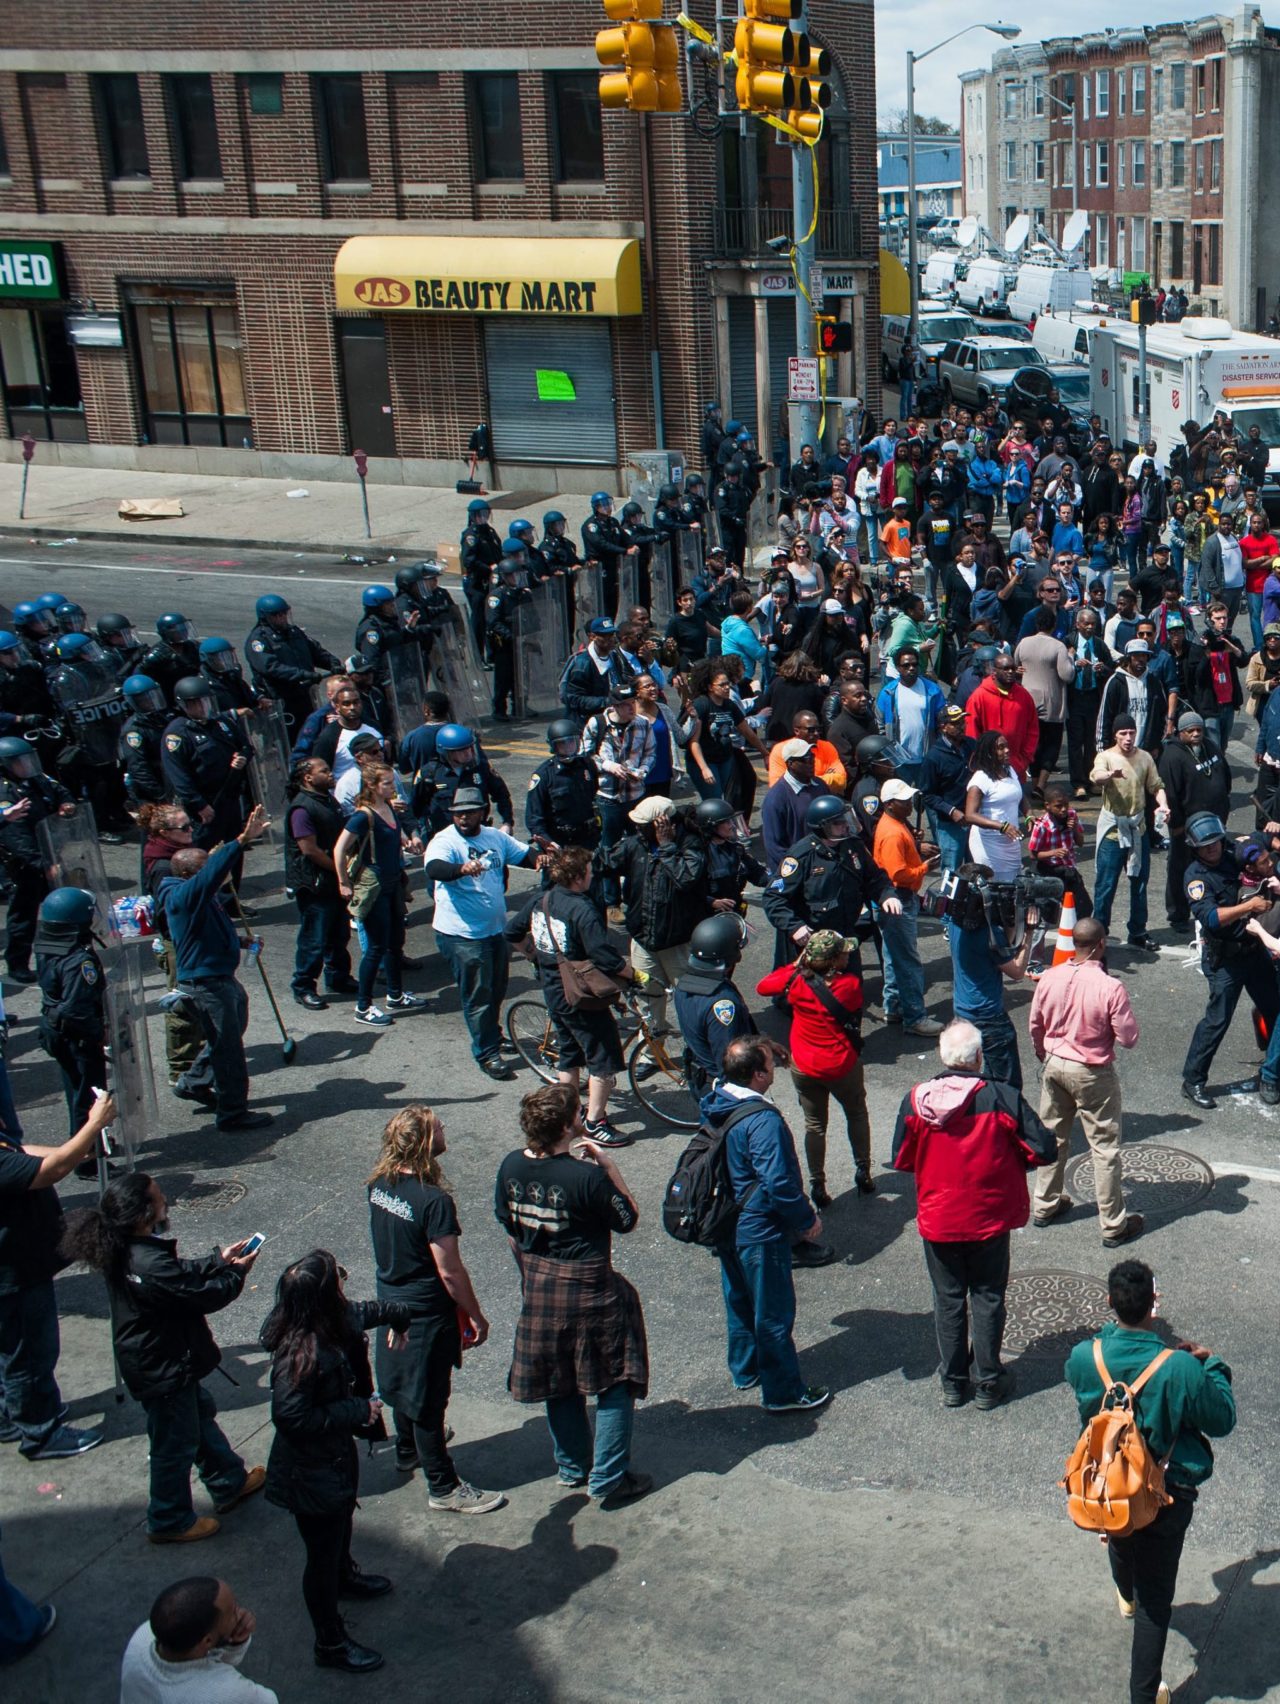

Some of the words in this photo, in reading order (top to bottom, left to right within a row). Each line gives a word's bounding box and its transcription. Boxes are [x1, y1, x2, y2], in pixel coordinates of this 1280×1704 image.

[766, 276, 784, 288] JAS
[827, 276, 853, 289] MART
[358, 282, 403, 304] JAS
[415, 279, 511, 310] BEAUTY
[520, 281, 597, 312] MART
[1237, 360, 1269, 370] SALVATION
[1222, 373, 1254, 381] DISASTER
